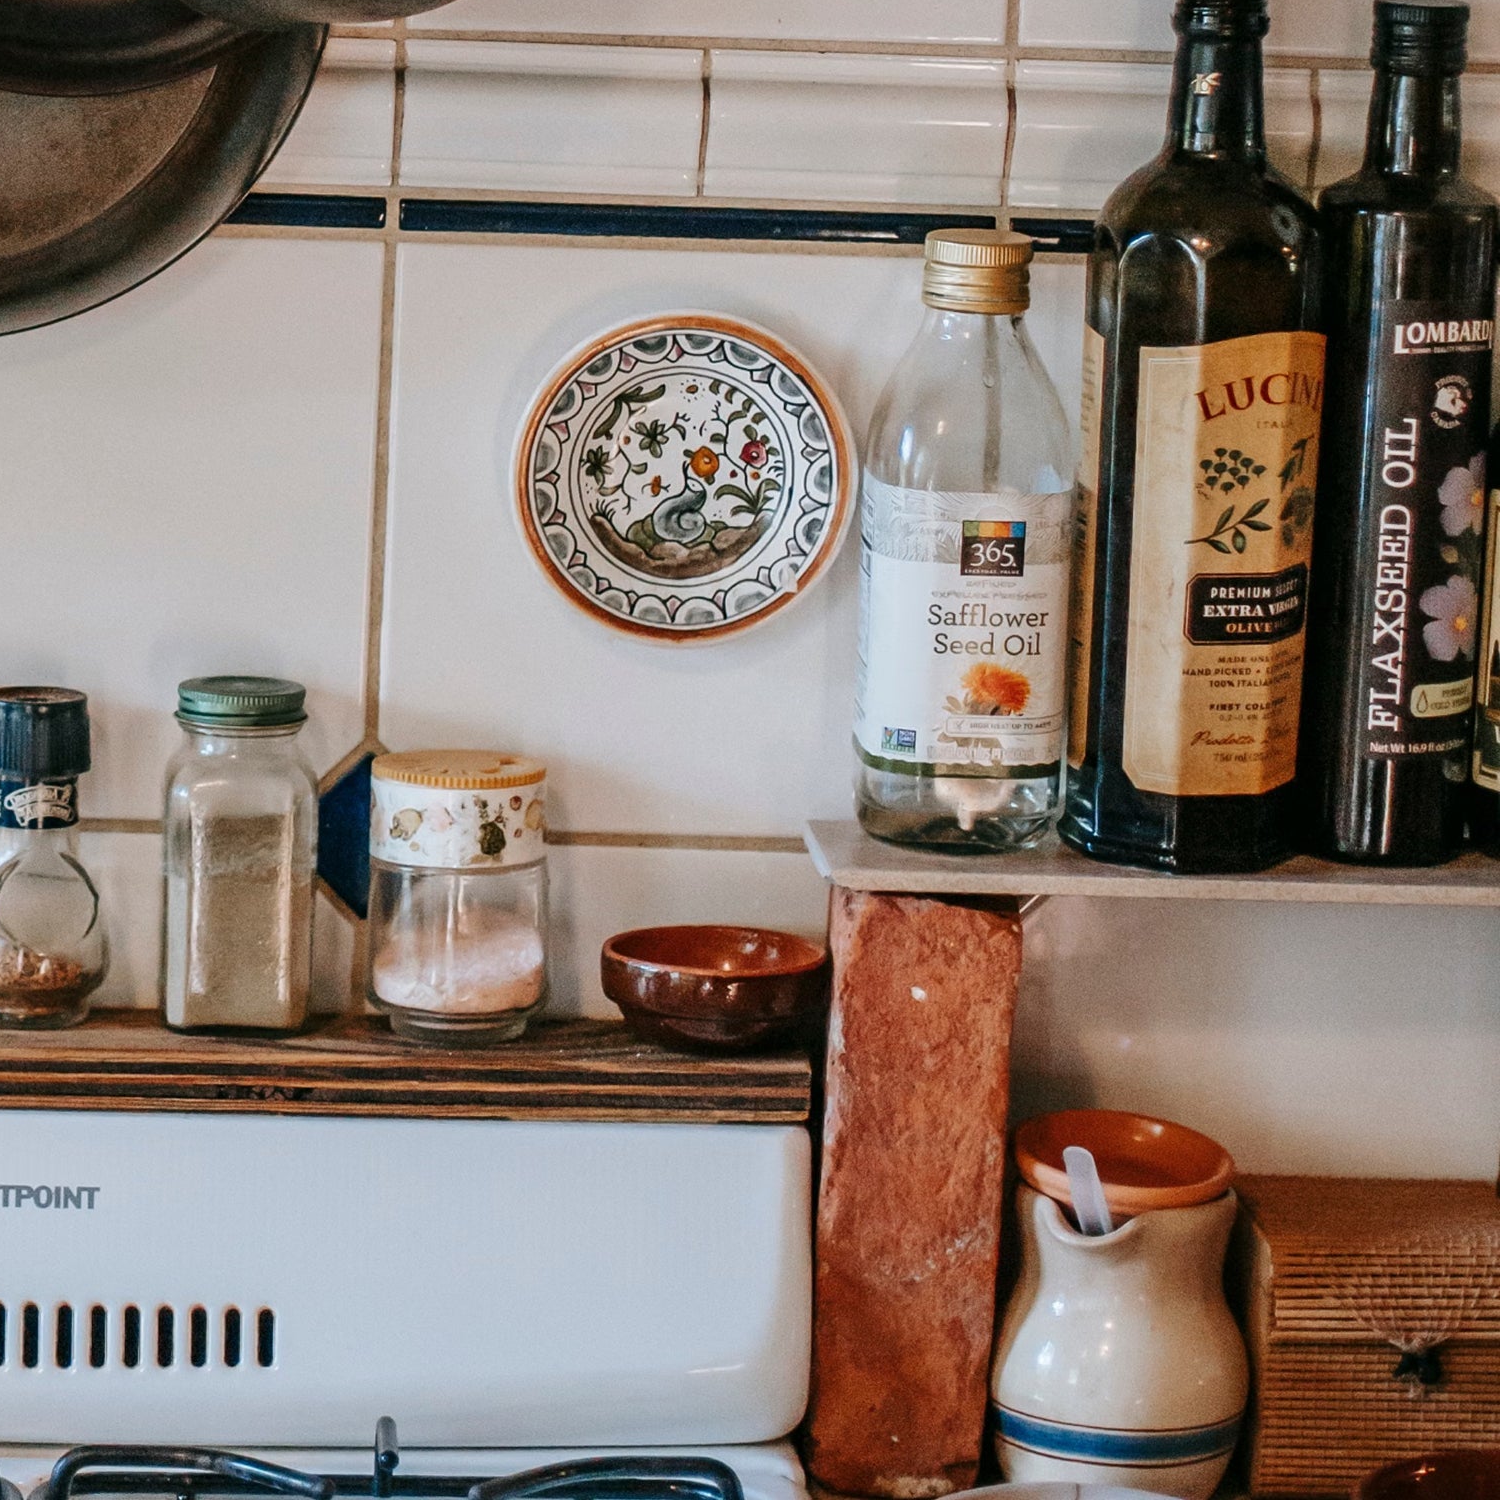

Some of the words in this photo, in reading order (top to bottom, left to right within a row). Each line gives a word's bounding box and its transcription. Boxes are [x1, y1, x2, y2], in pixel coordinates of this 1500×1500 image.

[1431, 411, 1460, 429] CANADA
[1382, 418, 1417, 488] OIL
[1210, 587, 1271, 599] PREMIUM
[1203, 604, 1264, 617] EXTRA
[1268, 595, 1300, 616] VIRGIN
[928, 603, 1049, 627] Safflower
[1368, 504, 1410, 732] FLAXSEED
[1225, 622, 1273, 633] OLIVE
[934, 632, 996, 655] Seed
[1004, 632, 1041, 656] Oil
[1182, 668, 1211, 676] HAND
[1214, 667, 1252, 676] PICKED
[1209, 703, 1240, 711] FIRST
[1011, 722, 1022, 730] UP
[1023, 722, 1033, 730] TO
[1369, 741, 1388, 753] Net
[1390, 742, 1405, 753] Wt
